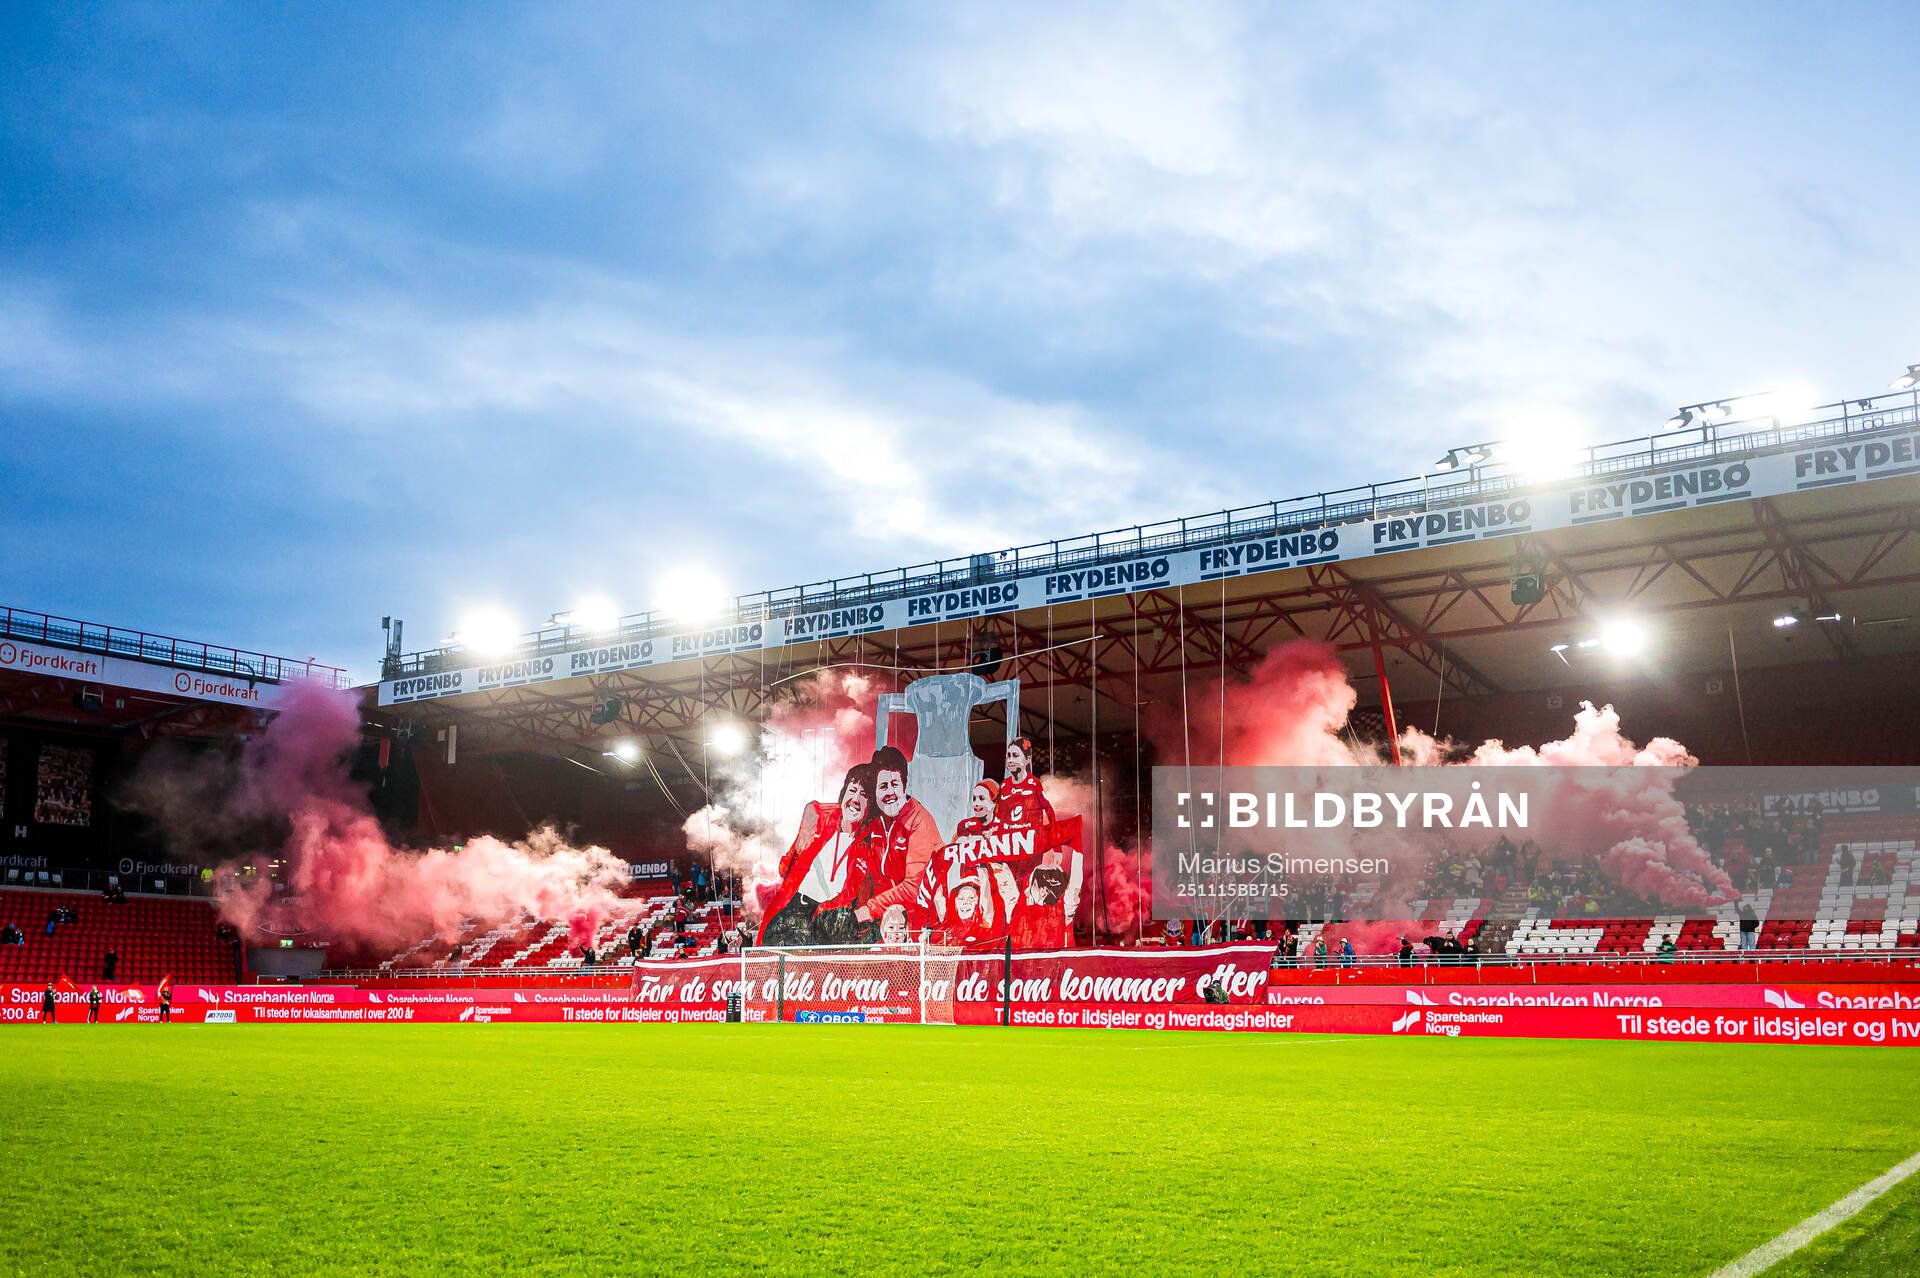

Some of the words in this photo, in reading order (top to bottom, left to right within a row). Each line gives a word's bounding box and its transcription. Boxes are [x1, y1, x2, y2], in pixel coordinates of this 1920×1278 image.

[1570, 461, 1750, 514] FRYDENBØ
[1373, 498, 1531, 544] FRYDENBØ
[1200, 528, 1339, 571] FRYDENBØ
[1046, 556, 1169, 595] FRYDENBØ
[908, 581, 1019, 617] FRYDENBØ
[785, 602, 884, 636] FRYDENBØ
[672, 622, 763, 653] FRYDENBØ
[20, 650, 97, 675] Fjordkraft
[571, 640, 653, 670] FRYDENBØ
[478, 657, 554, 683] FRYDENBØ
[194, 678, 259, 701] Fjordkraft
[393, 671, 462, 697] FRYDENBØ
[1764, 788, 1880, 810] FYENBØ
[15, 825, 27, 838] H
[944, 830, 1036, 864] BRANN
[136, 862, 199, 876] Fjordkraft
[626, 863, 668, 875] YDENBØ
[635, 976, 674, 1002] For
[680, 976, 707, 1002] de
[711, 979, 756, 1002] som
[762, 972, 815, 1001] gkk
[956, 971, 989, 1002] de
[996, 978, 1051, 1002] som
[1060, 968, 1186, 1003] kommer
[1196, 963, 1267, 999] etter
[11, 988, 102, 1004] Sparbanke
[224, 990, 309, 1003] Sparebanken
[310, 991, 335, 1003] Norge
[603, 993, 629, 1003] Norg
[1268, 992, 1324, 1004] Norge
[1449, 991, 1588, 1007] Sparebanken
[1593, 991, 1663, 1008] Norge
[26, 1007, 40, 1020] år
[138, 1007, 185, 1015] Sparenken
[253, 1007, 266, 1018] Til
[266, 1008, 290, 1019] stede
[290, 1008, 302, 1019] for
[303, 1008, 363, 1019] lokalsamfunnet
[364, 1008, 367, 1019] i
[368, 1010, 387, 1019] over
[387, 1008, 403, 1019] 200
[404, 1007, 415, 1019] år
[475, 1007, 512, 1015] Sparebanken
[562, 1007, 574, 1020] Til
[575, 1008, 603, 1021] stede
[605, 1008, 620, 1020] for
[622, 1008, 663, 1023] ildsjeler
[664, 1011, 679, 1023] og
[681, 1007, 765, 1023] hverdagelter
[822, 1014, 860, 1023] OBOS
[861, 1005, 912, 1015] Sparebken
[994, 1007, 1011, 1023] Tl
[1014, 1008, 1055, 1024] stede
[1057, 1008, 1079, 1025] for
[1082, 1009, 1142, 1029] ildsjeler
[1144, 1013, 1166, 1028] og
[1169, 1011, 1294, 1030] hverdagshelter
[1425, 1011, 1503, 1024] Sparebanken
[474, 1015, 491, 1023] Norge
[1425, 1022, 1461, 1036] Norge
[1617, 1014, 1642, 1034] Til
[1646, 1015, 1711, 1035] stede
[1715, 1016, 1748, 1036] for
[1753, 1016, 1847, 1040] ildsjeler
[1853, 1021, 1886, 1042] og
[1892, 1018, 1920, 1038] hv
